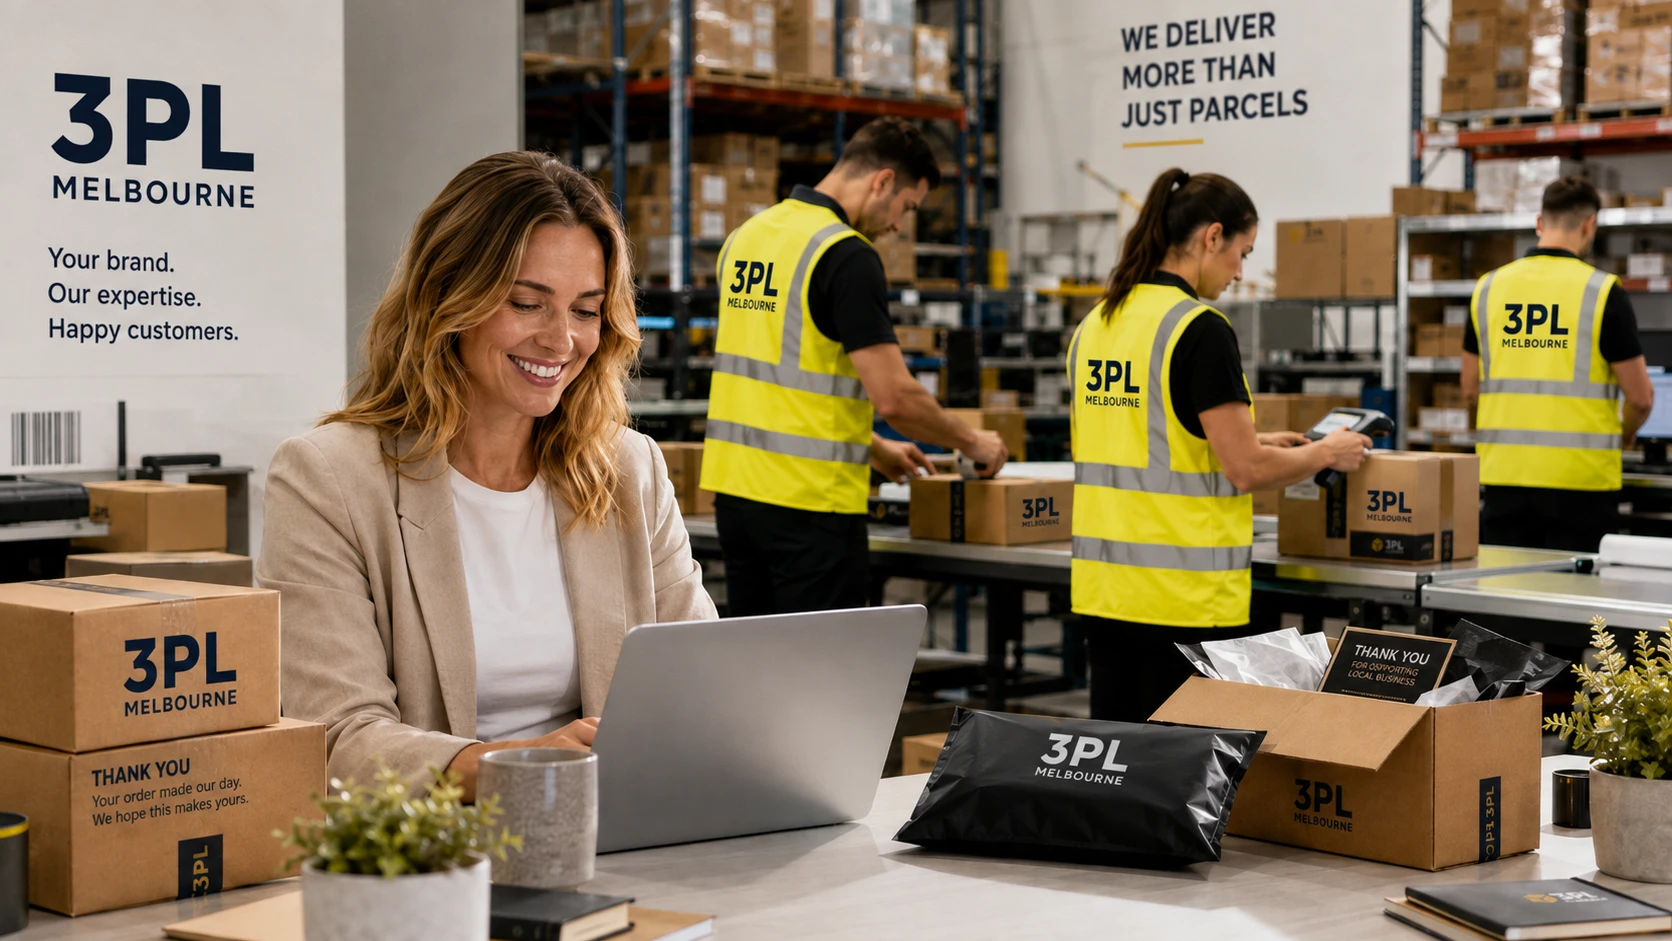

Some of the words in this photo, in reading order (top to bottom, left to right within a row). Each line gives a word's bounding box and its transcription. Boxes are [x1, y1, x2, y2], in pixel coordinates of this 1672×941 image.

[1121, 25, 1158, 52] WE
[1166, 12, 1276, 48] DELIVER
[1123, 59, 1195, 90] MORE
[1203, 52, 1275, 82] THAN
[51, 73, 255, 172] 3PL
[1121, 99, 1182, 128] JUST
[1190, 89, 1308, 123] PARCELS
[53, 176, 255, 208] MELBOURNE
[48, 247, 100, 270] Your
[107, 249, 175, 273] brand.
[730, 260, 778, 297] 3PL
[48, 283, 90, 304] Our
[98, 285, 201, 310] expertise.
[727, 297, 776, 312] MELBOURNE
[49, 318, 121, 344] Happy
[128, 321, 239, 341] customers.
[1503, 303, 1569, 335] 3PL
[1501, 338, 1568, 349] MELBOURNE
[1086, 360, 1140, 393] 3PL
[1085, 395, 1140, 409] MELBOURNE
[1022, 497, 1060, 518] 3PL
[1367, 490, 1412, 513] 3PL
[1366, 513, 1412, 523] MELBOURNE
[1385, 539, 1404, 550] 3PL
[124, 632, 237, 693] 3PL
[1354, 644, 1400, 662] THANK
[1402, 651, 1431, 666] YOU
[1347, 669, 1374, 681] LOCAL
[1375, 673, 1416, 687] BUSINESS
[125, 689, 237, 717] MELBOURNE
[1040, 733, 1128, 772] 3PL
[91, 763, 151, 787] THANK
[155, 758, 190, 779] YOU
[1035, 766, 1124, 786] MELBOURNE
[92, 795, 121, 808] Your
[123, 788, 157, 803] order
[159, 782, 193, 799] made
[196, 780, 216, 793] our
[219, 777, 242, 791] day.
[1294, 778, 1353, 819] 3PL
[1485, 786, 1495, 818] 3PL
[92, 813, 113, 826] We
[115, 810, 147, 824] hope
[149, 804, 171, 819] this
[175, 799, 212, 815] makes
[215, 794, 249, 811] yours.
[1294, 812, 1353, 832] MELBOURNE
[193, 845, 209, 891] 3PL
